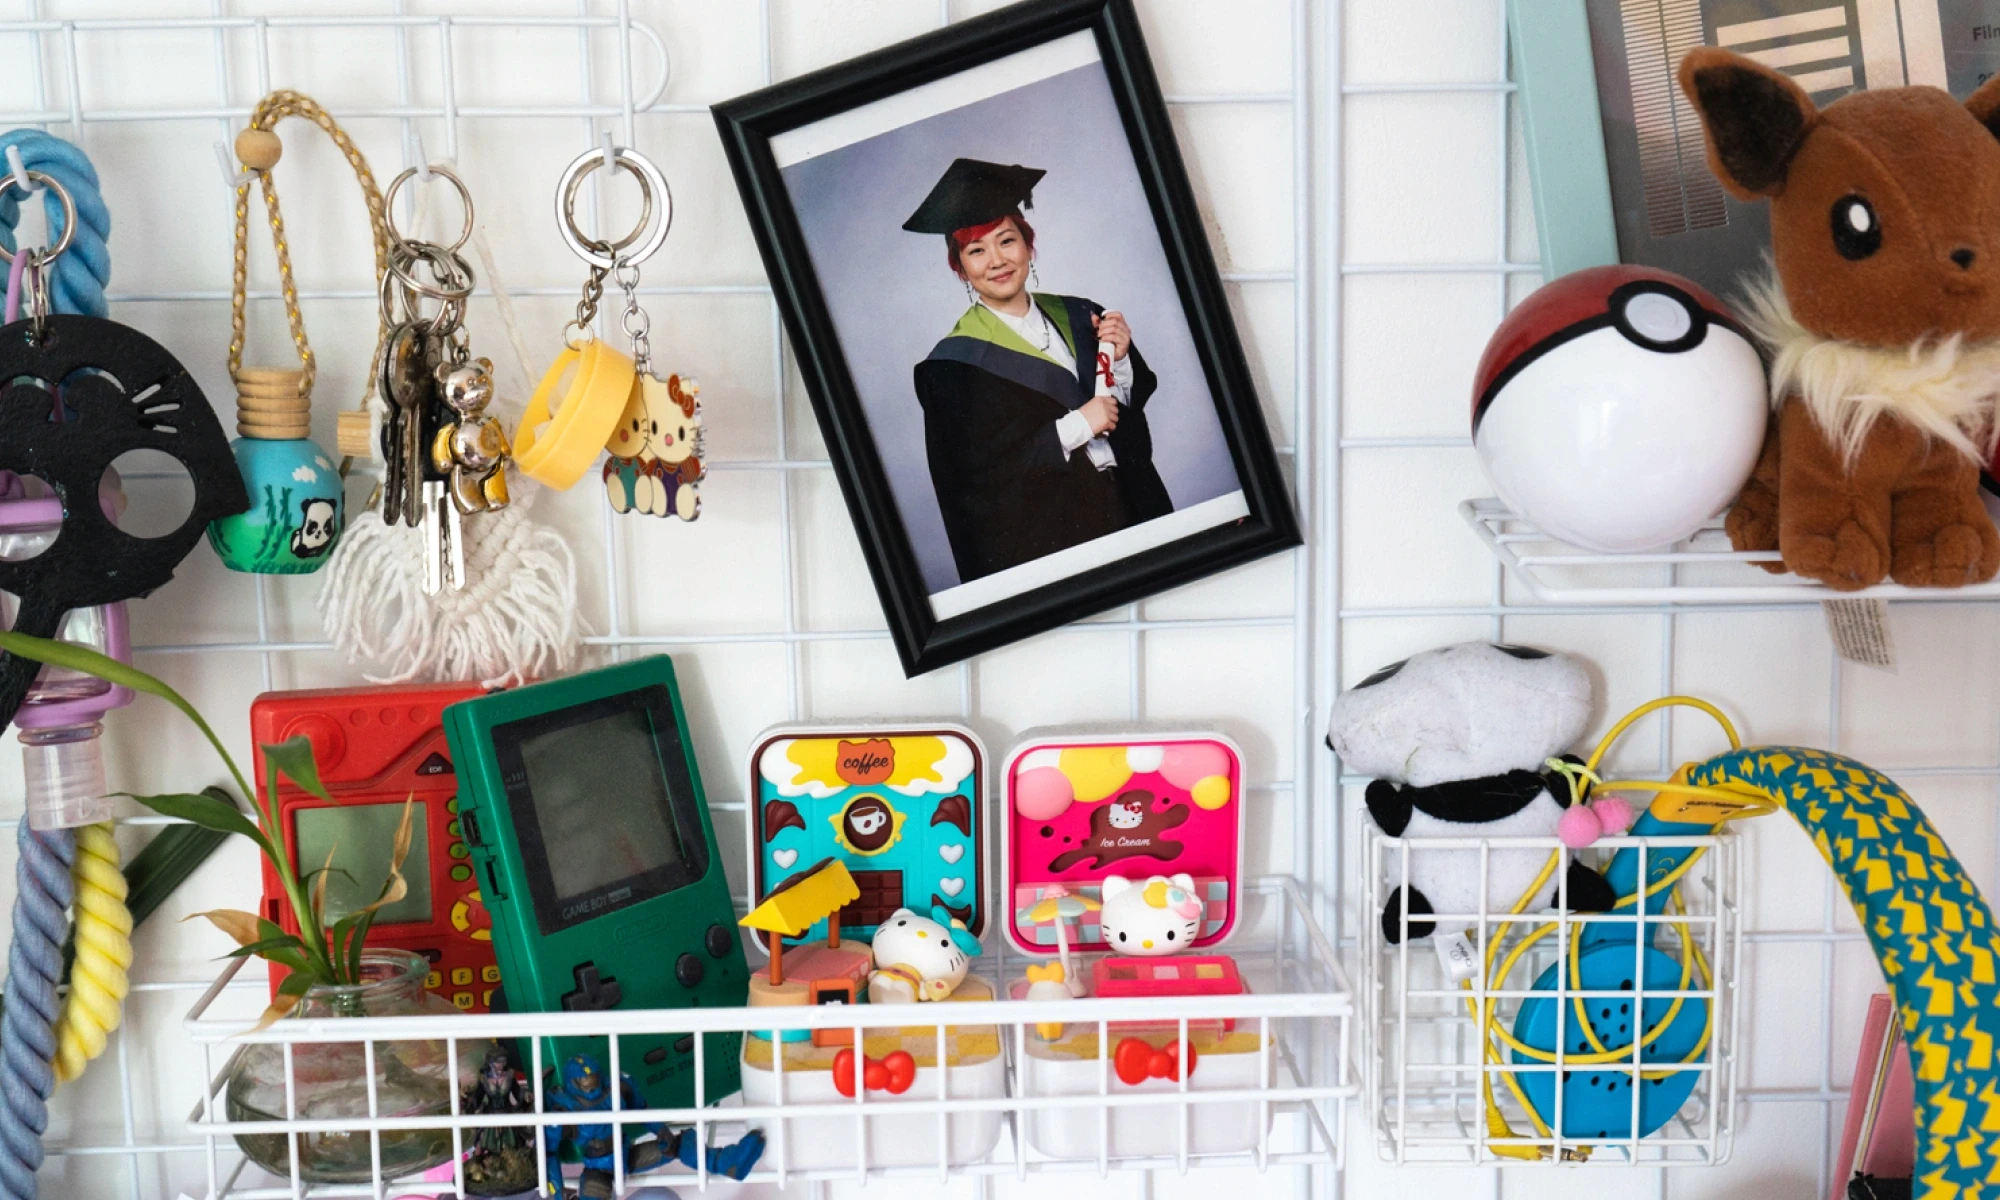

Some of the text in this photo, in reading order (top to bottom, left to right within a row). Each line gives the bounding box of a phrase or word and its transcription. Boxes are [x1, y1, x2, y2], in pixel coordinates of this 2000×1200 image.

[843, 752, 889, 775] coffee
[1100, 836, 1151, 847] Ice Cream
[562, 900, 591, 919] GAME
[591, 894, 608, 910] BOY
[459, 972, 466, 982] F
[487, 969, 498, 980] G
[458, 996, 470, 1006] M
